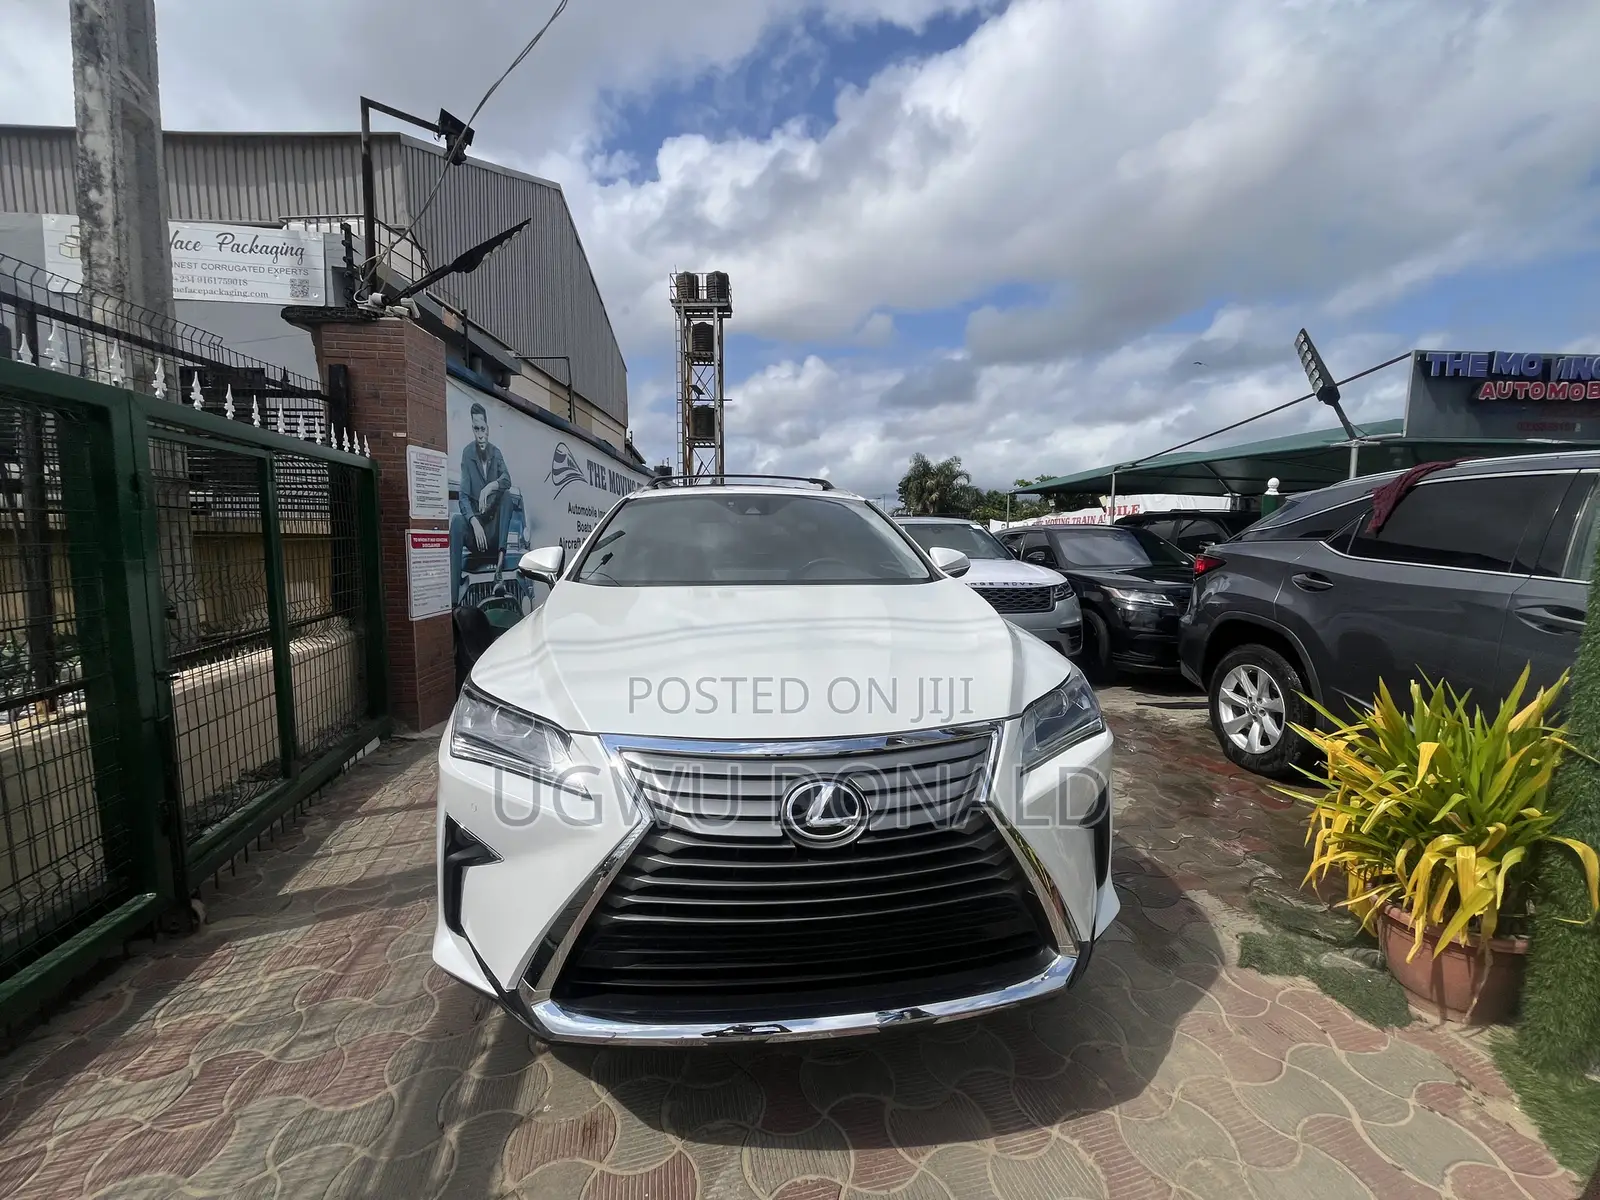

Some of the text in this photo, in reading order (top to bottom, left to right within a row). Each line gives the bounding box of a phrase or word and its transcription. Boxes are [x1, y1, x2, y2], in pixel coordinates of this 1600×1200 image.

[216, 232, 306, 266] Packaging
[201, 262, 265, 275] CORRUGATED
[267, 266, 310, 276] EXPERTS
[1426, 352, 1490, 378] THE
[586, 458, 636, 497] THE MOVING
[568, 501, 598, 518] Automobile
[1071, 515, 1097, 524] TRAIN
